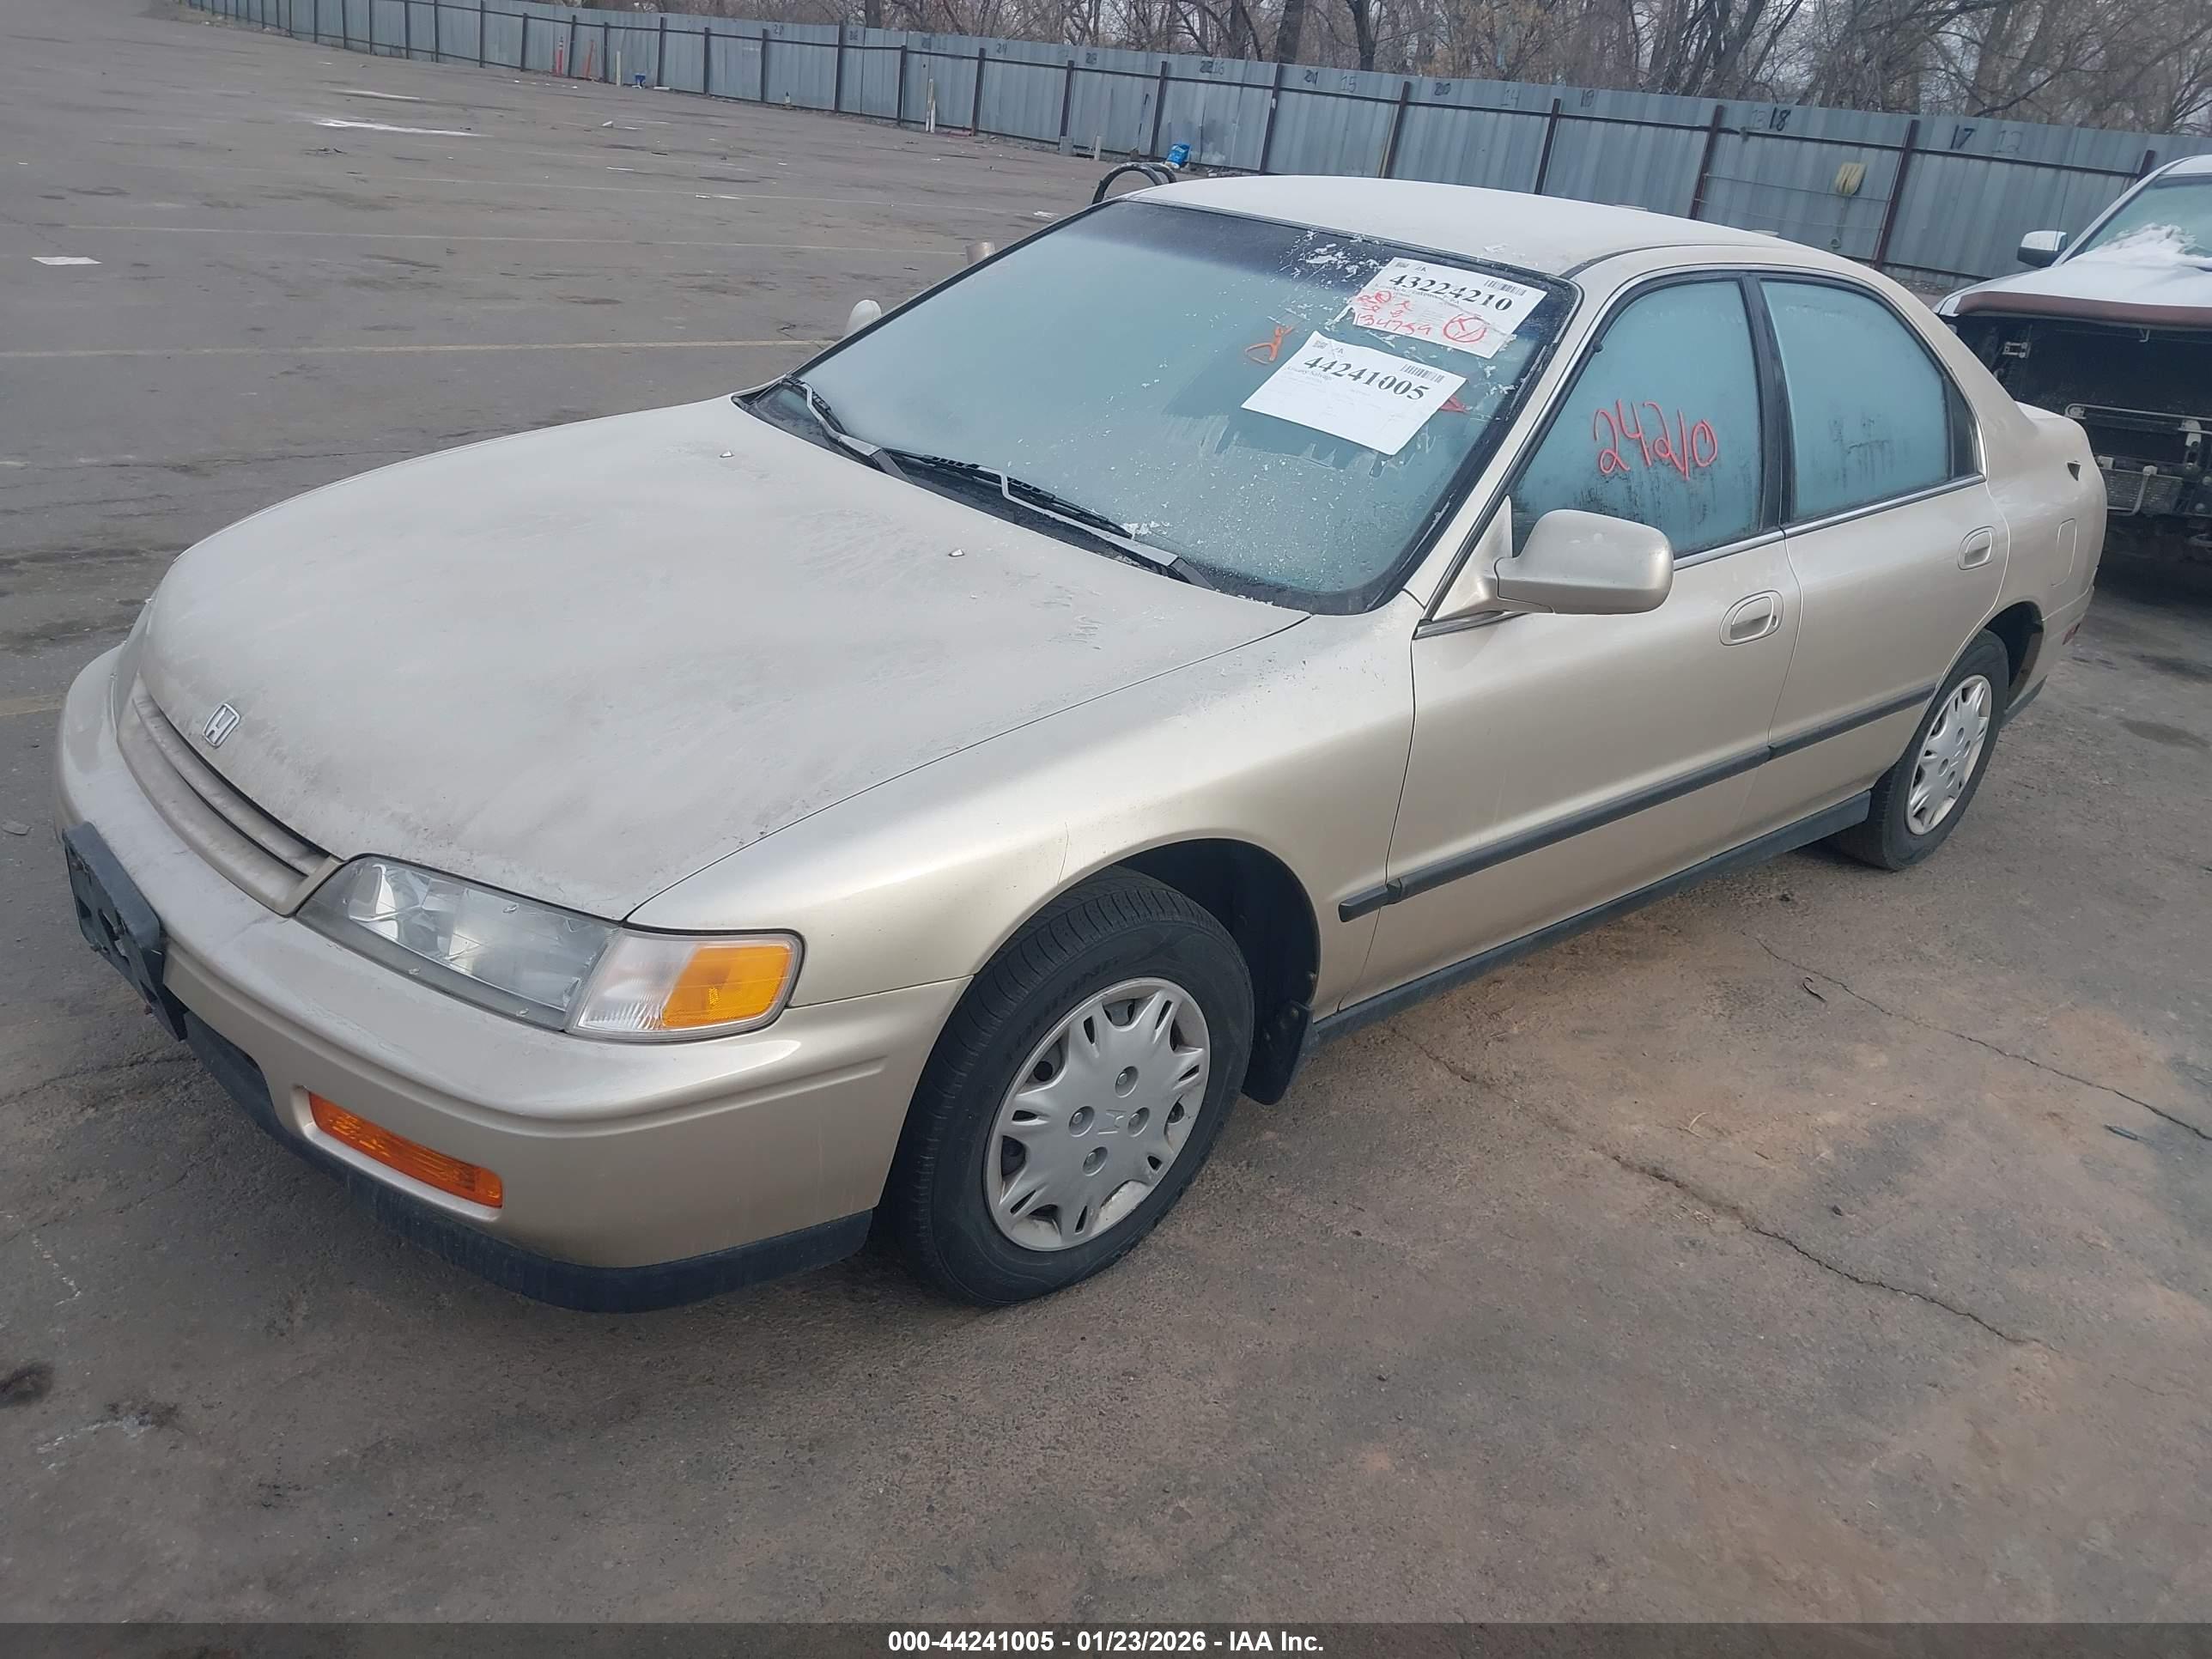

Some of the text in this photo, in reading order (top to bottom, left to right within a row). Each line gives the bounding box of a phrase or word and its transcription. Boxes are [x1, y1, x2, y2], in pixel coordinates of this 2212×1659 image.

[1340, 76, 1357, 93] 15
[1770, 106, 1791, 131] 18
[1950, 125, 1976, 149] 17
[1389, 273, 1513, 311] 43224210
[1304, 356, 1431, 400] 44241005
[1594, 398, 1718, 481] 24210
